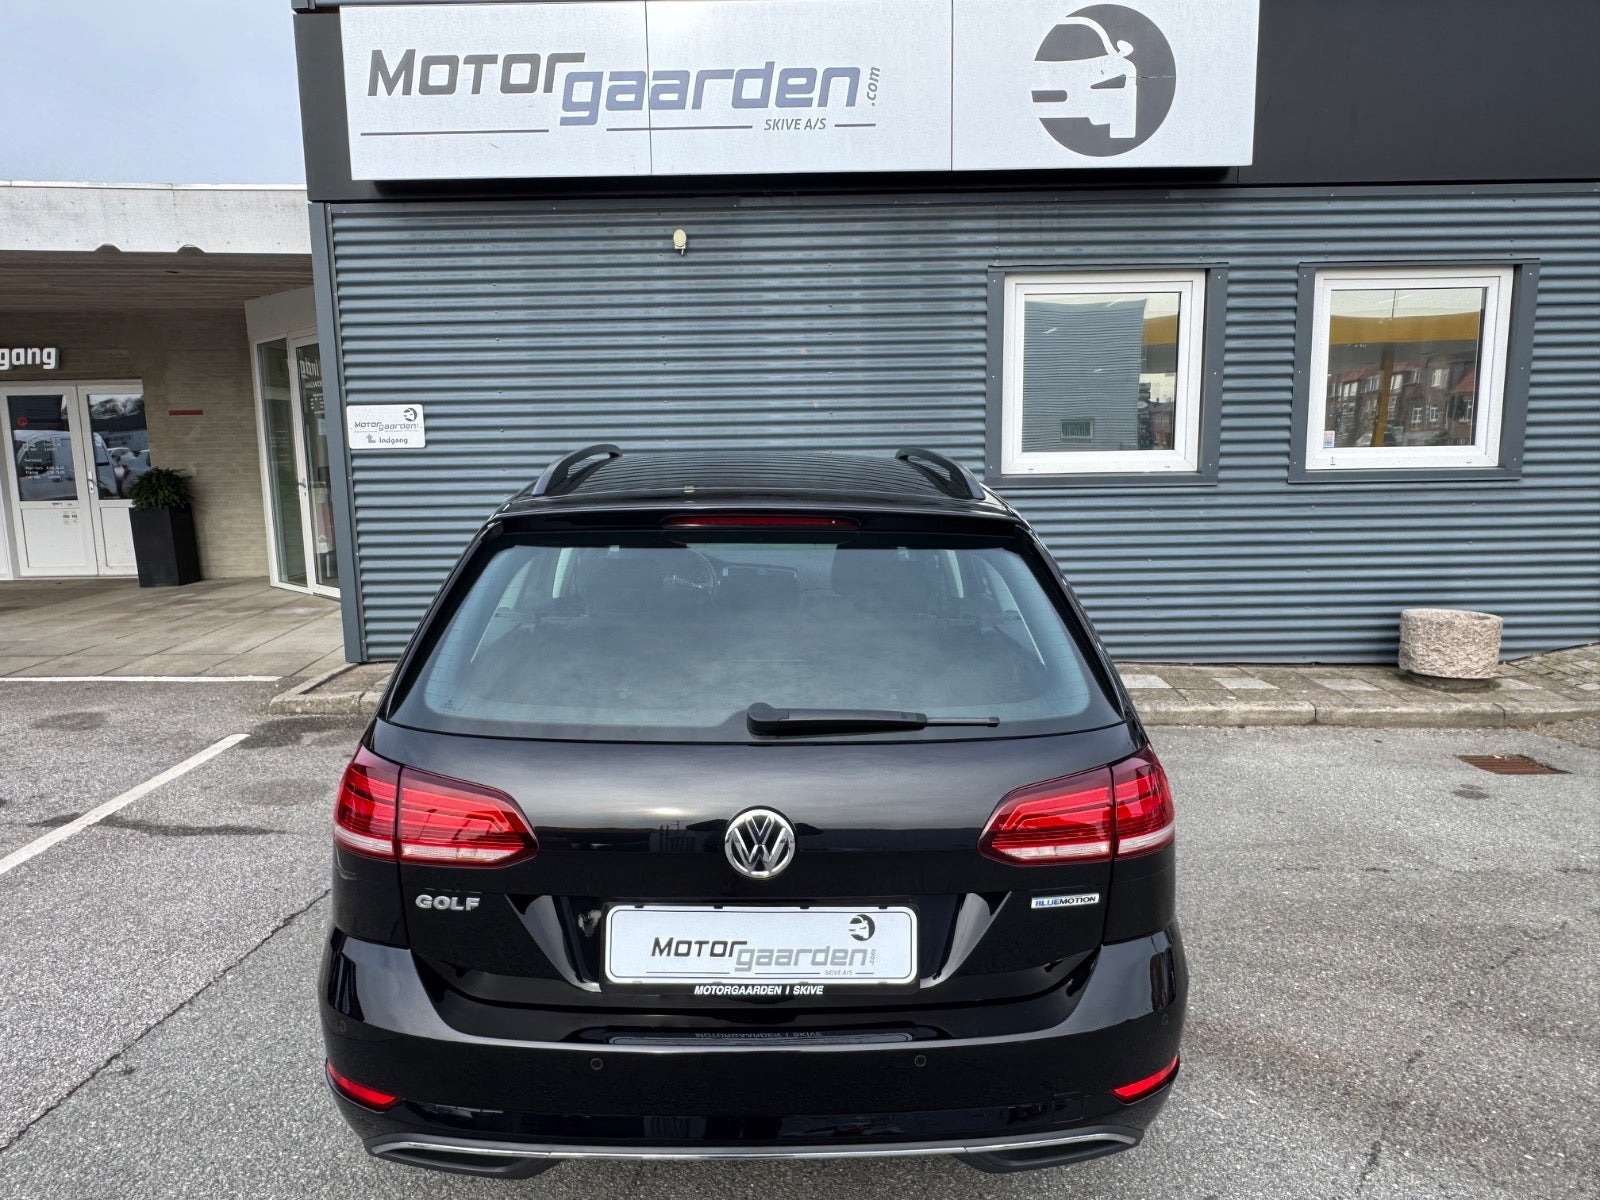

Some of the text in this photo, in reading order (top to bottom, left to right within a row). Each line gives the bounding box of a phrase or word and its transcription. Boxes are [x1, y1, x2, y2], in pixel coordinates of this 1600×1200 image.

[559, 61, 861, 127] gaarden
[764, 117, 827, 131] SKIVE A/S
[379, 437, 408, 445] Indgang
[415, 894, 480, 911] GOLF
[1035, 896, 1097, 907] BLUEMOTION
[735, 946, 868, 972] gaarden
[694, 985, 783, 996] MOTORGAARDEN
[793, 985, 825, 996] SKIVE
